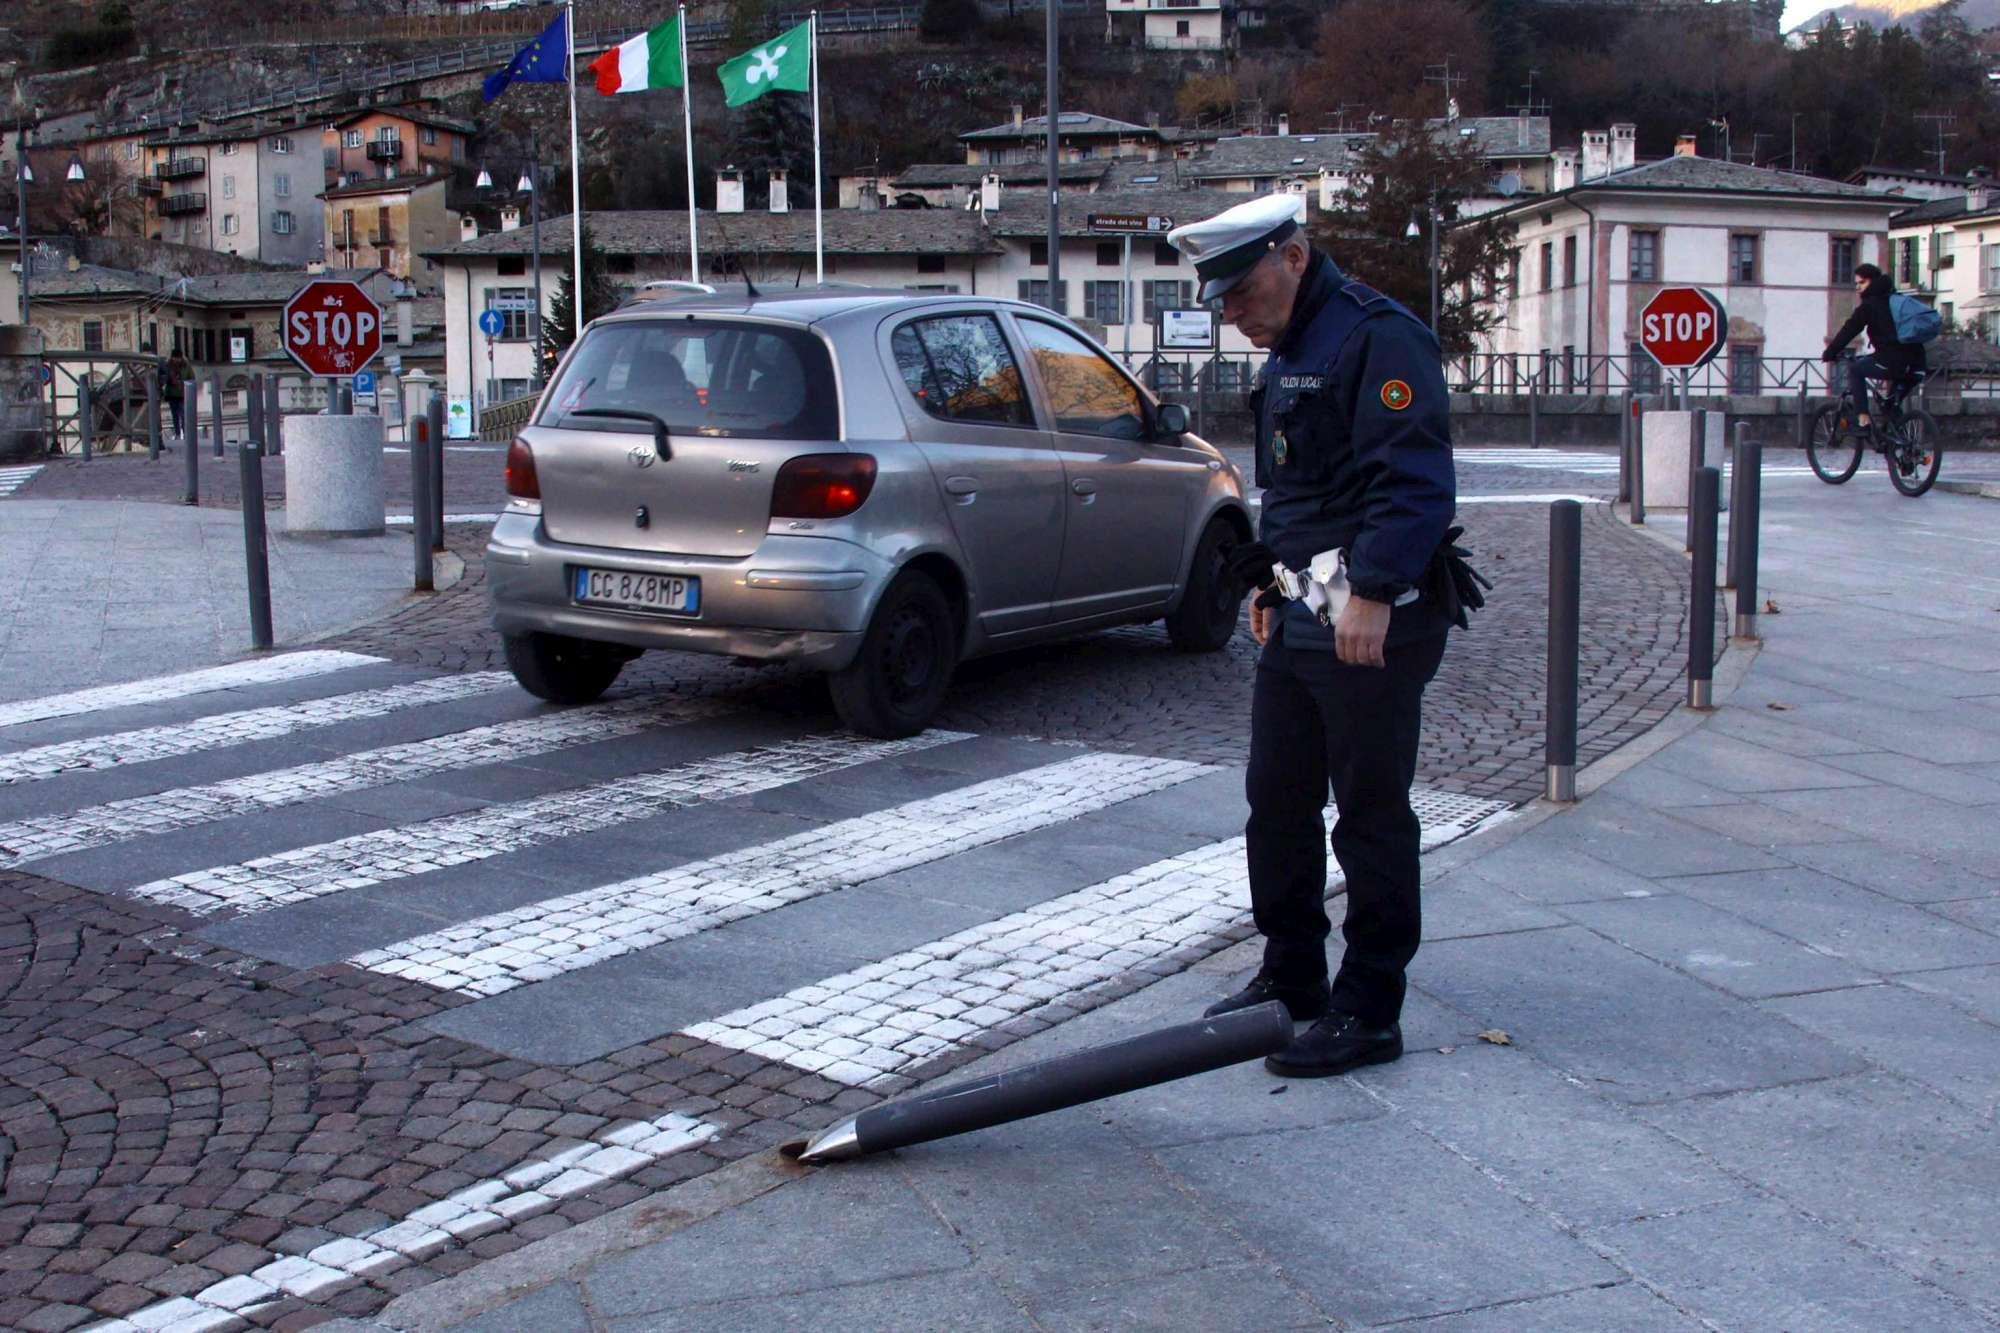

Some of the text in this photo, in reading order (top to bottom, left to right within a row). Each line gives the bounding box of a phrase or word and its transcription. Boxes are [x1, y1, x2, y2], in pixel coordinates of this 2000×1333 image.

[291, 310, 375, 346] STOP
[1645, 312, 1711, 343] STOP
[356, 373, 369, 391] P
[590, 572, 684, 606] CG 848MP
